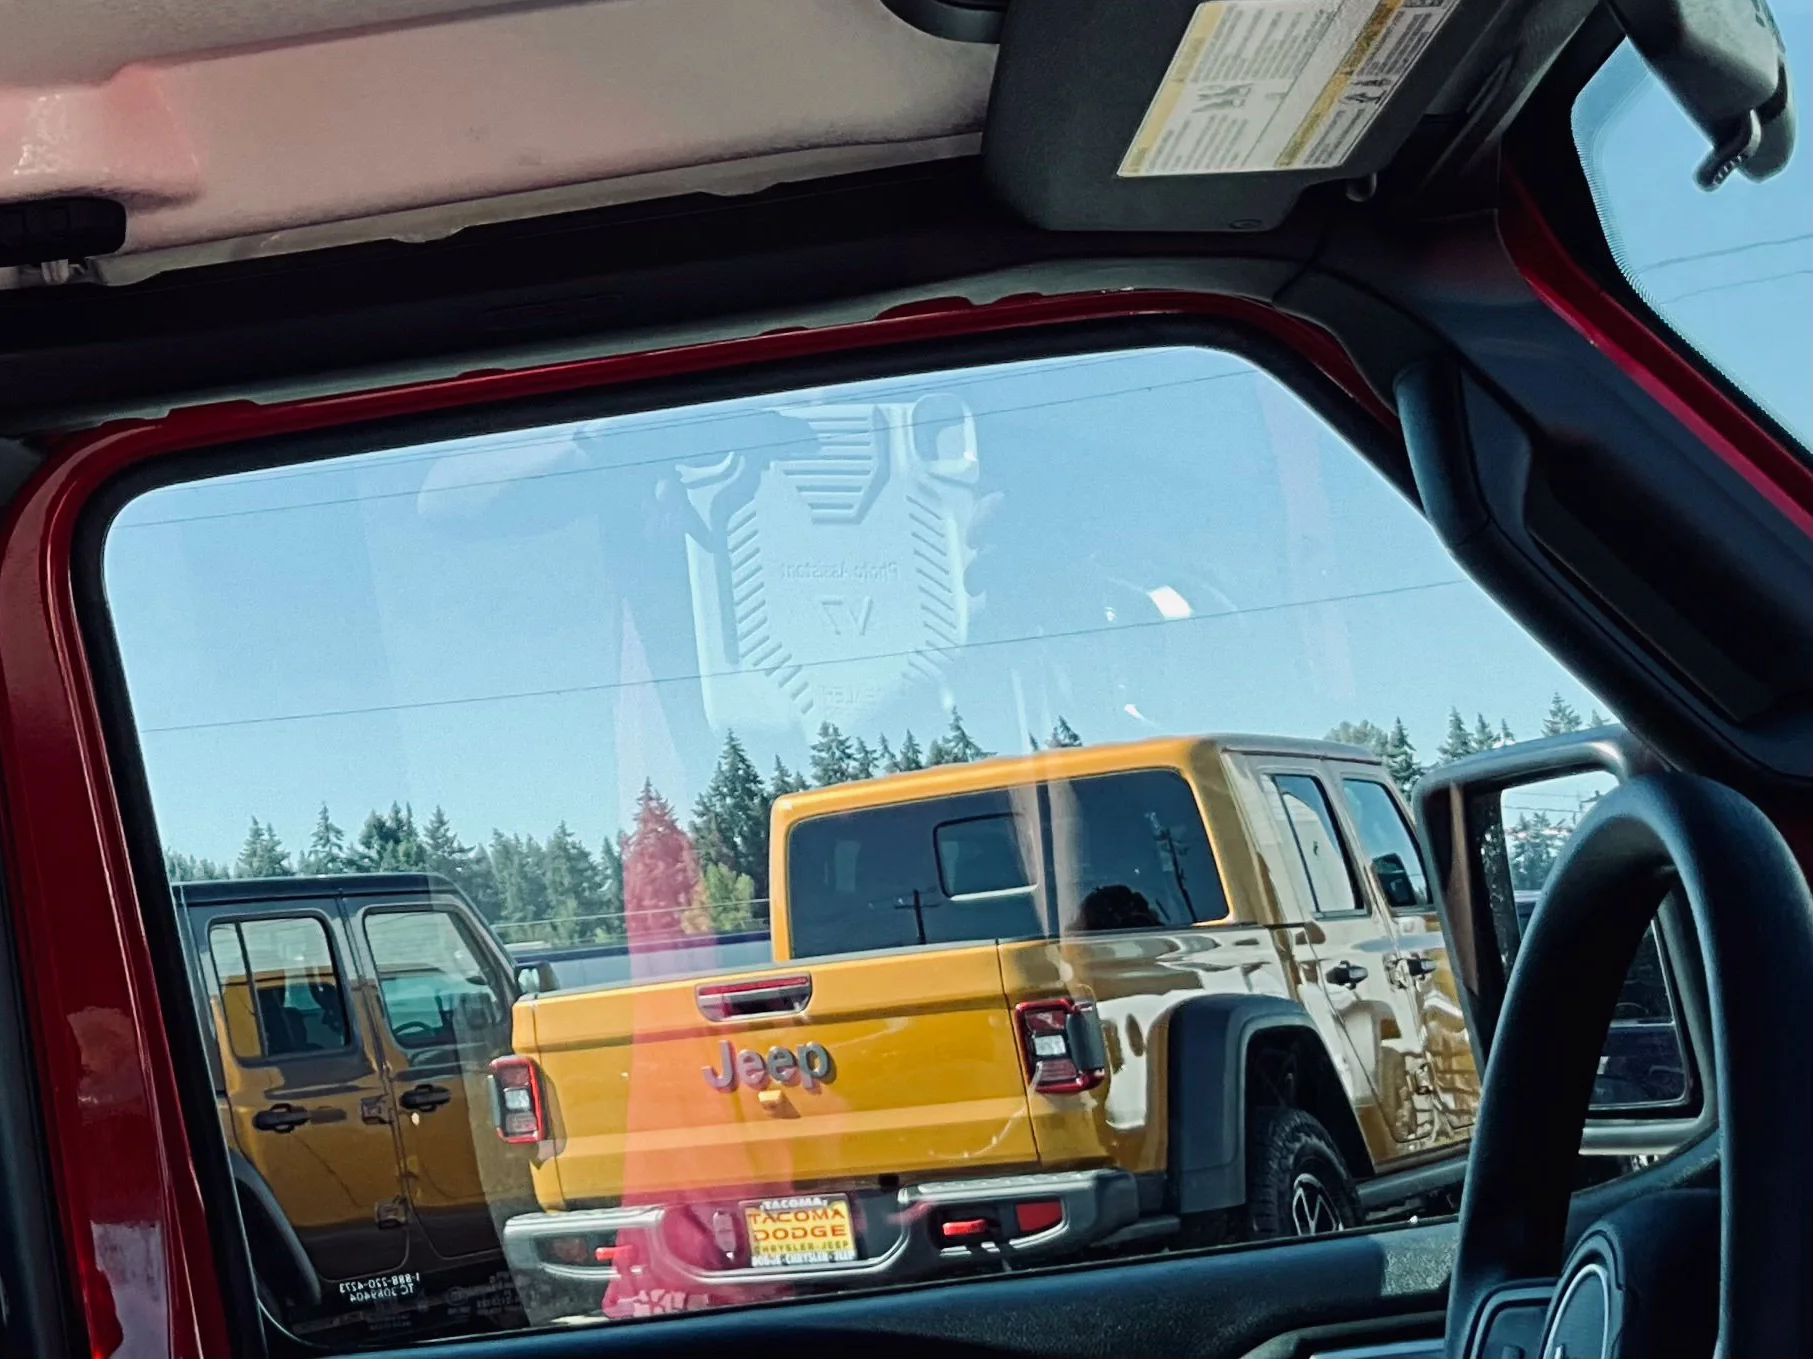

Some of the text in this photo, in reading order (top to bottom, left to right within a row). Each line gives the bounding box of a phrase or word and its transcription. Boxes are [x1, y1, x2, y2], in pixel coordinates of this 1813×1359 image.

[701, 1040, 829, 1089] Jeep
[762, 1197, 823, 1211] TACOMA
[748, 1208, 845, 1225] TACOMA
[754, 1225, 848, 1241] DODGE
[754, 1240, 849, 1254] CHRYSLER JEEP
